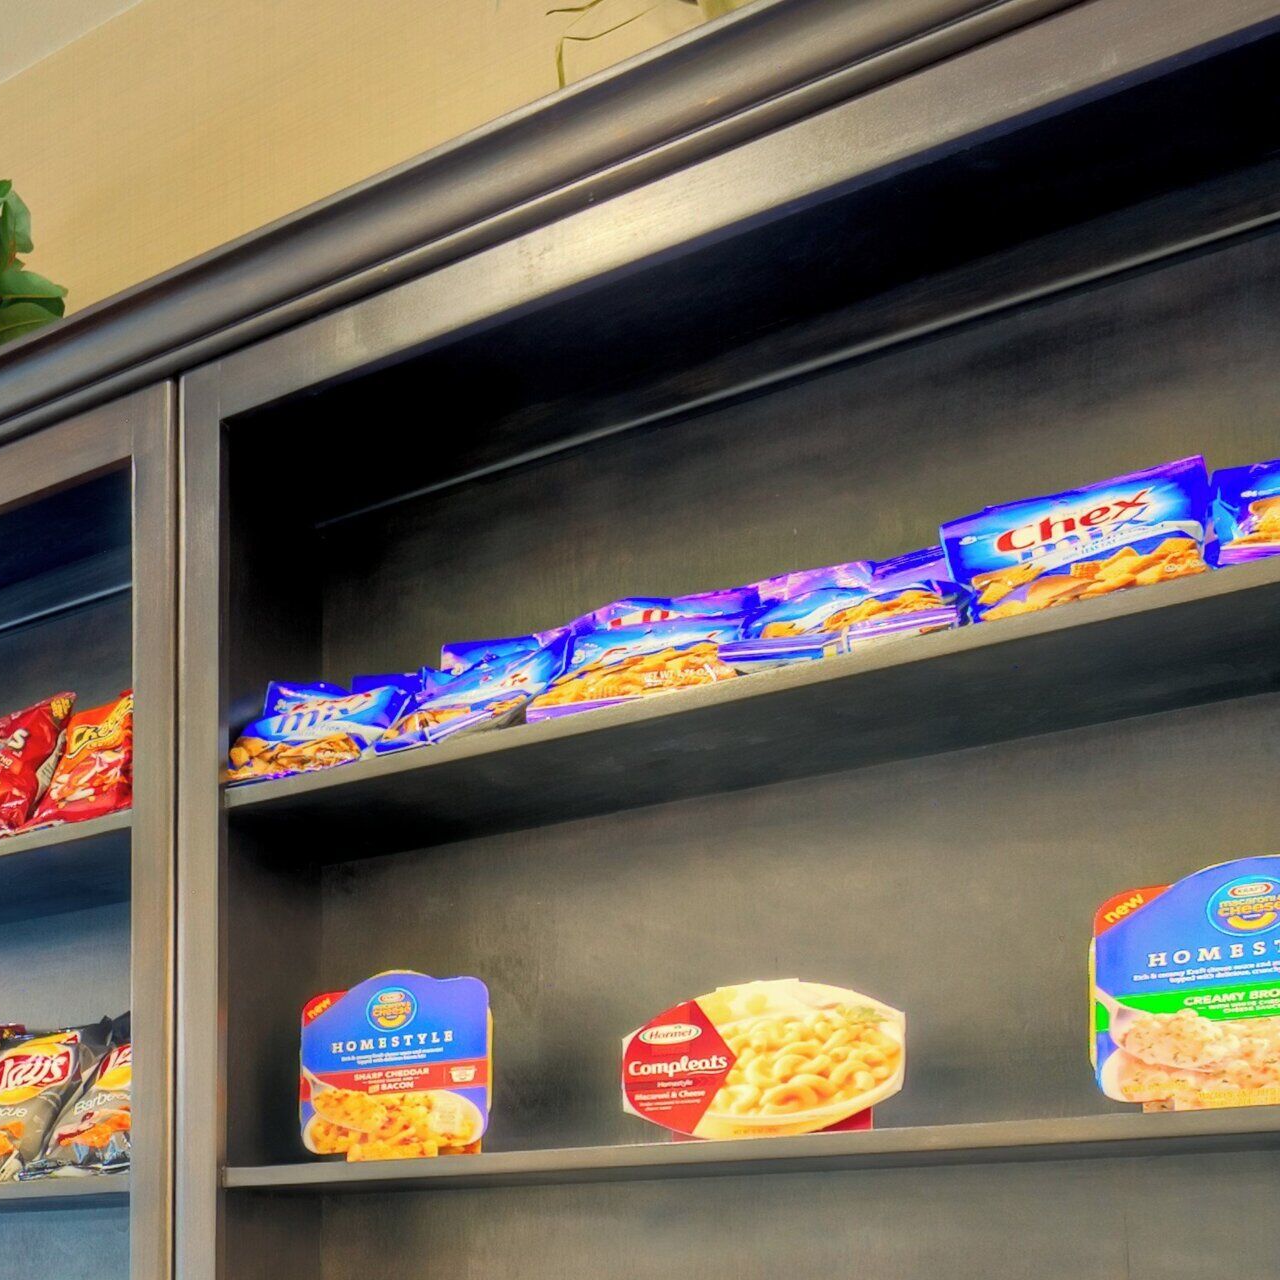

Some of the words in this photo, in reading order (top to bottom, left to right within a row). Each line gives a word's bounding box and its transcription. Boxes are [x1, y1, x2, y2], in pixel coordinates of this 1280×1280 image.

[996, 486, 1155, 553] Chex
[1103, 893, 1145, 924] new
[307, 997, 332, 1020] new
[1183, 991, 1246, 1007] CREAMY
[331, 1030, 454, 1055] HOMESTYLE
[648, 1028, 693, 1040] Hormel
[0, 1053, 70, 1095] Lay's
[354, 1071, 384, 1082] SHARP
[385, 1067, 430, 1078] CHEDDAR
[628, 1055, 728, 1078] Compleats
[381, 1081, 414, 1091] BACON
